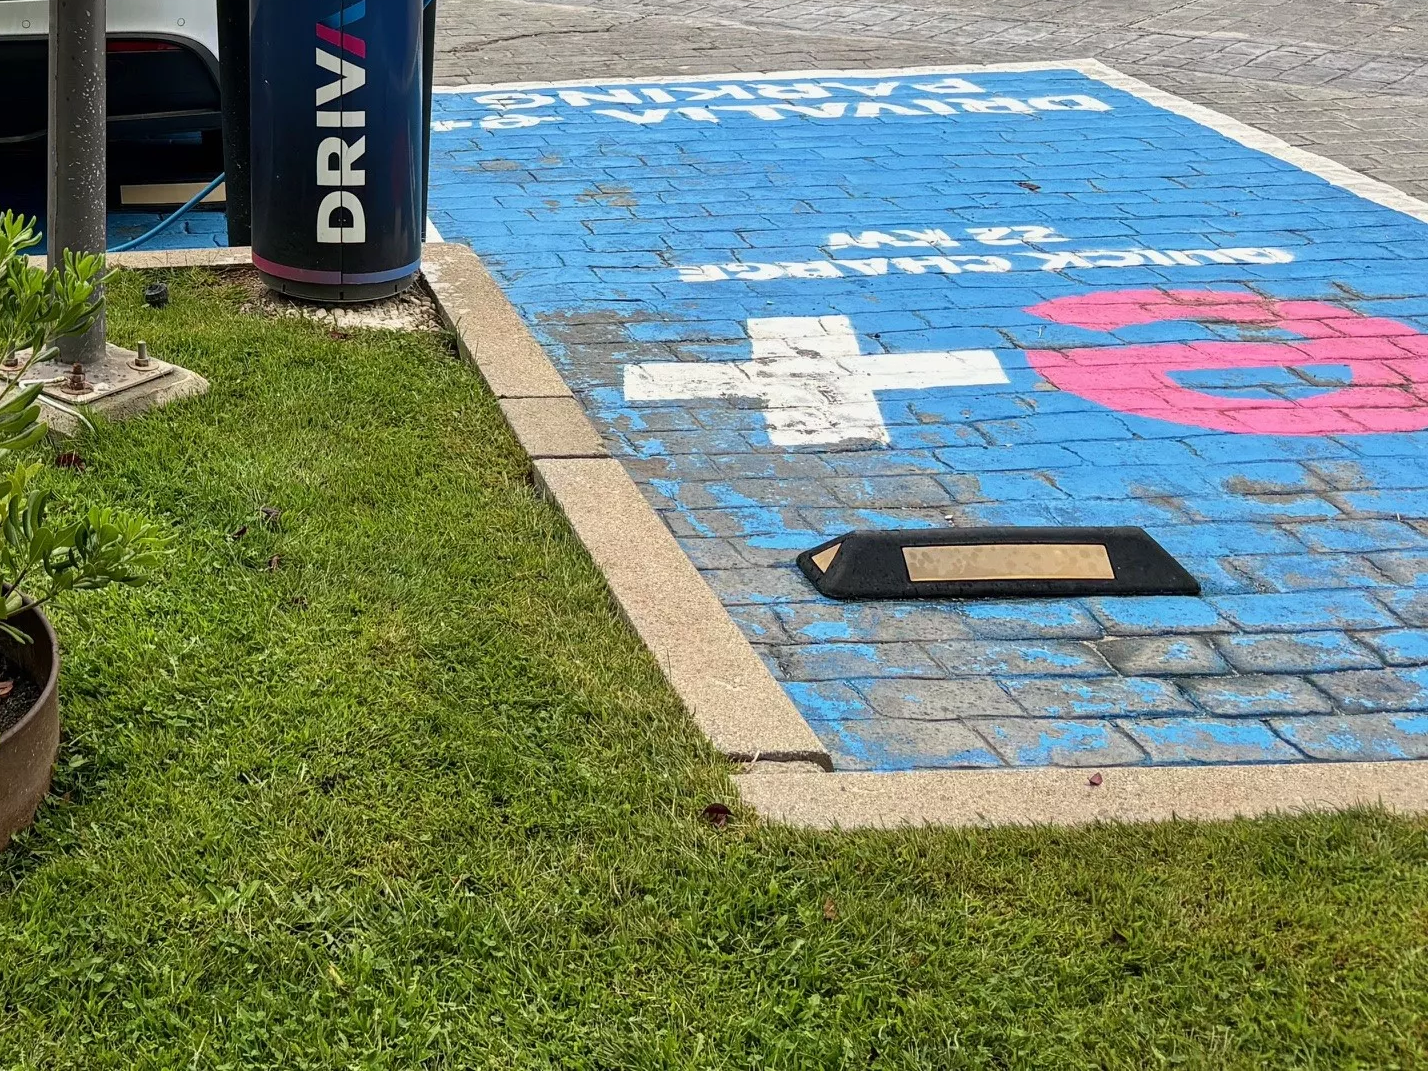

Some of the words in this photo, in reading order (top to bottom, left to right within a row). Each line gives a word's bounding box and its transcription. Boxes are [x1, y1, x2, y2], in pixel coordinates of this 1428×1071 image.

[472, 77, 986, 111] PARKING
[592, 94, 1116, 126] DRIVALIA
[964, 224, 1071, 245] 22
[676, 252, 1014, 283] CHARGE
[1025, 246, 1297, 271] QUICK
